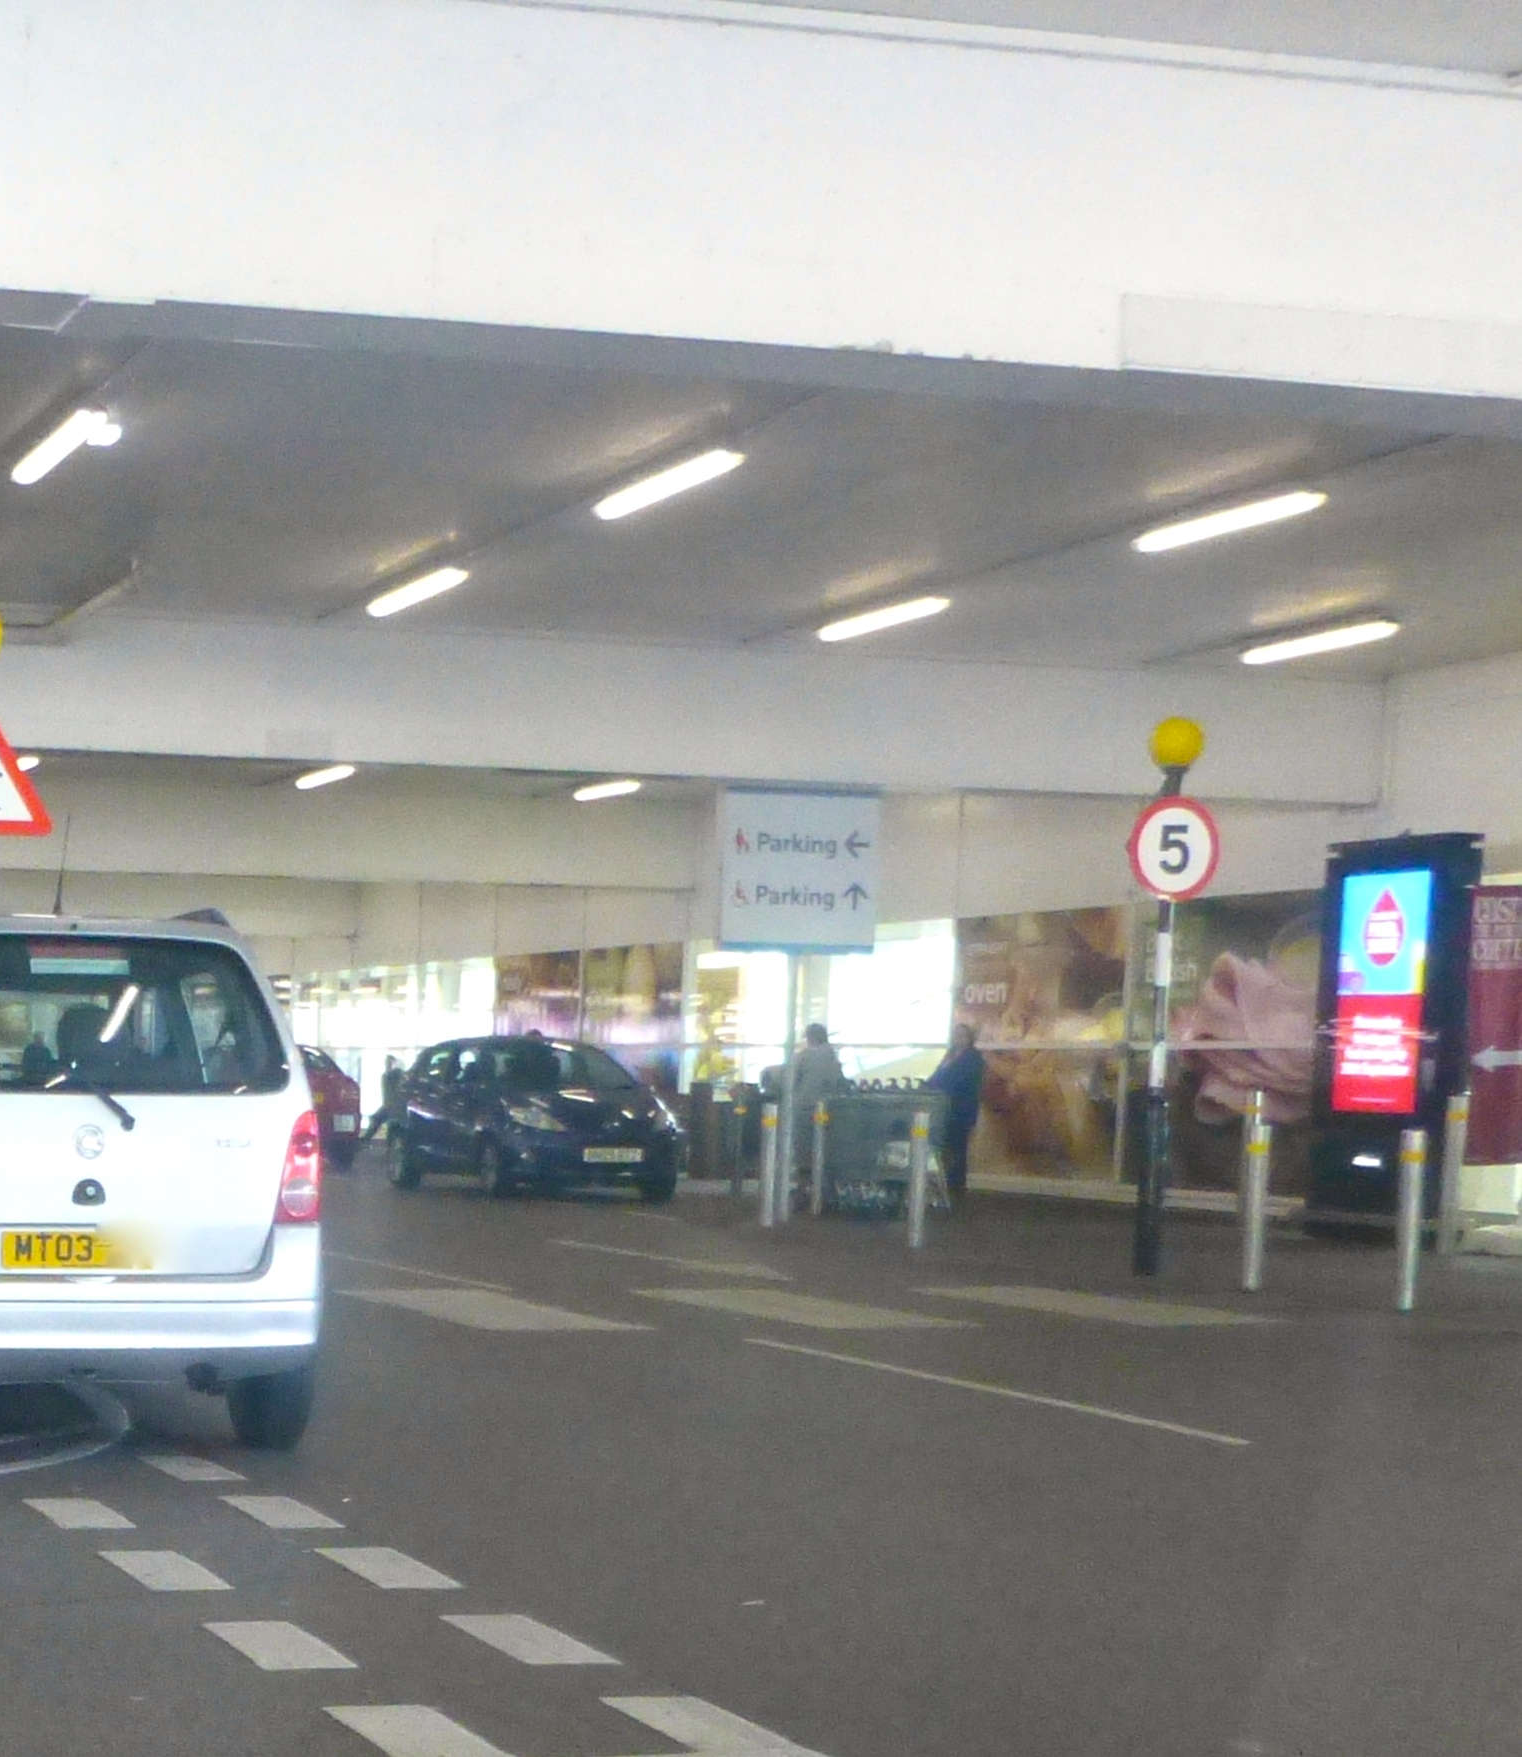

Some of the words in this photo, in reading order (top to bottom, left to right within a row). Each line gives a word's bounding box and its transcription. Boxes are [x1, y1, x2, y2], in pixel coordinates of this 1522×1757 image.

[757, 831, 838, 859] Parking
[1159, 824, 1190, 874] 5
[755, 885, 835, 911] Parking
[964, 982, 1008, 1004] oven
[14, 1233, 93, 1262] MT03
